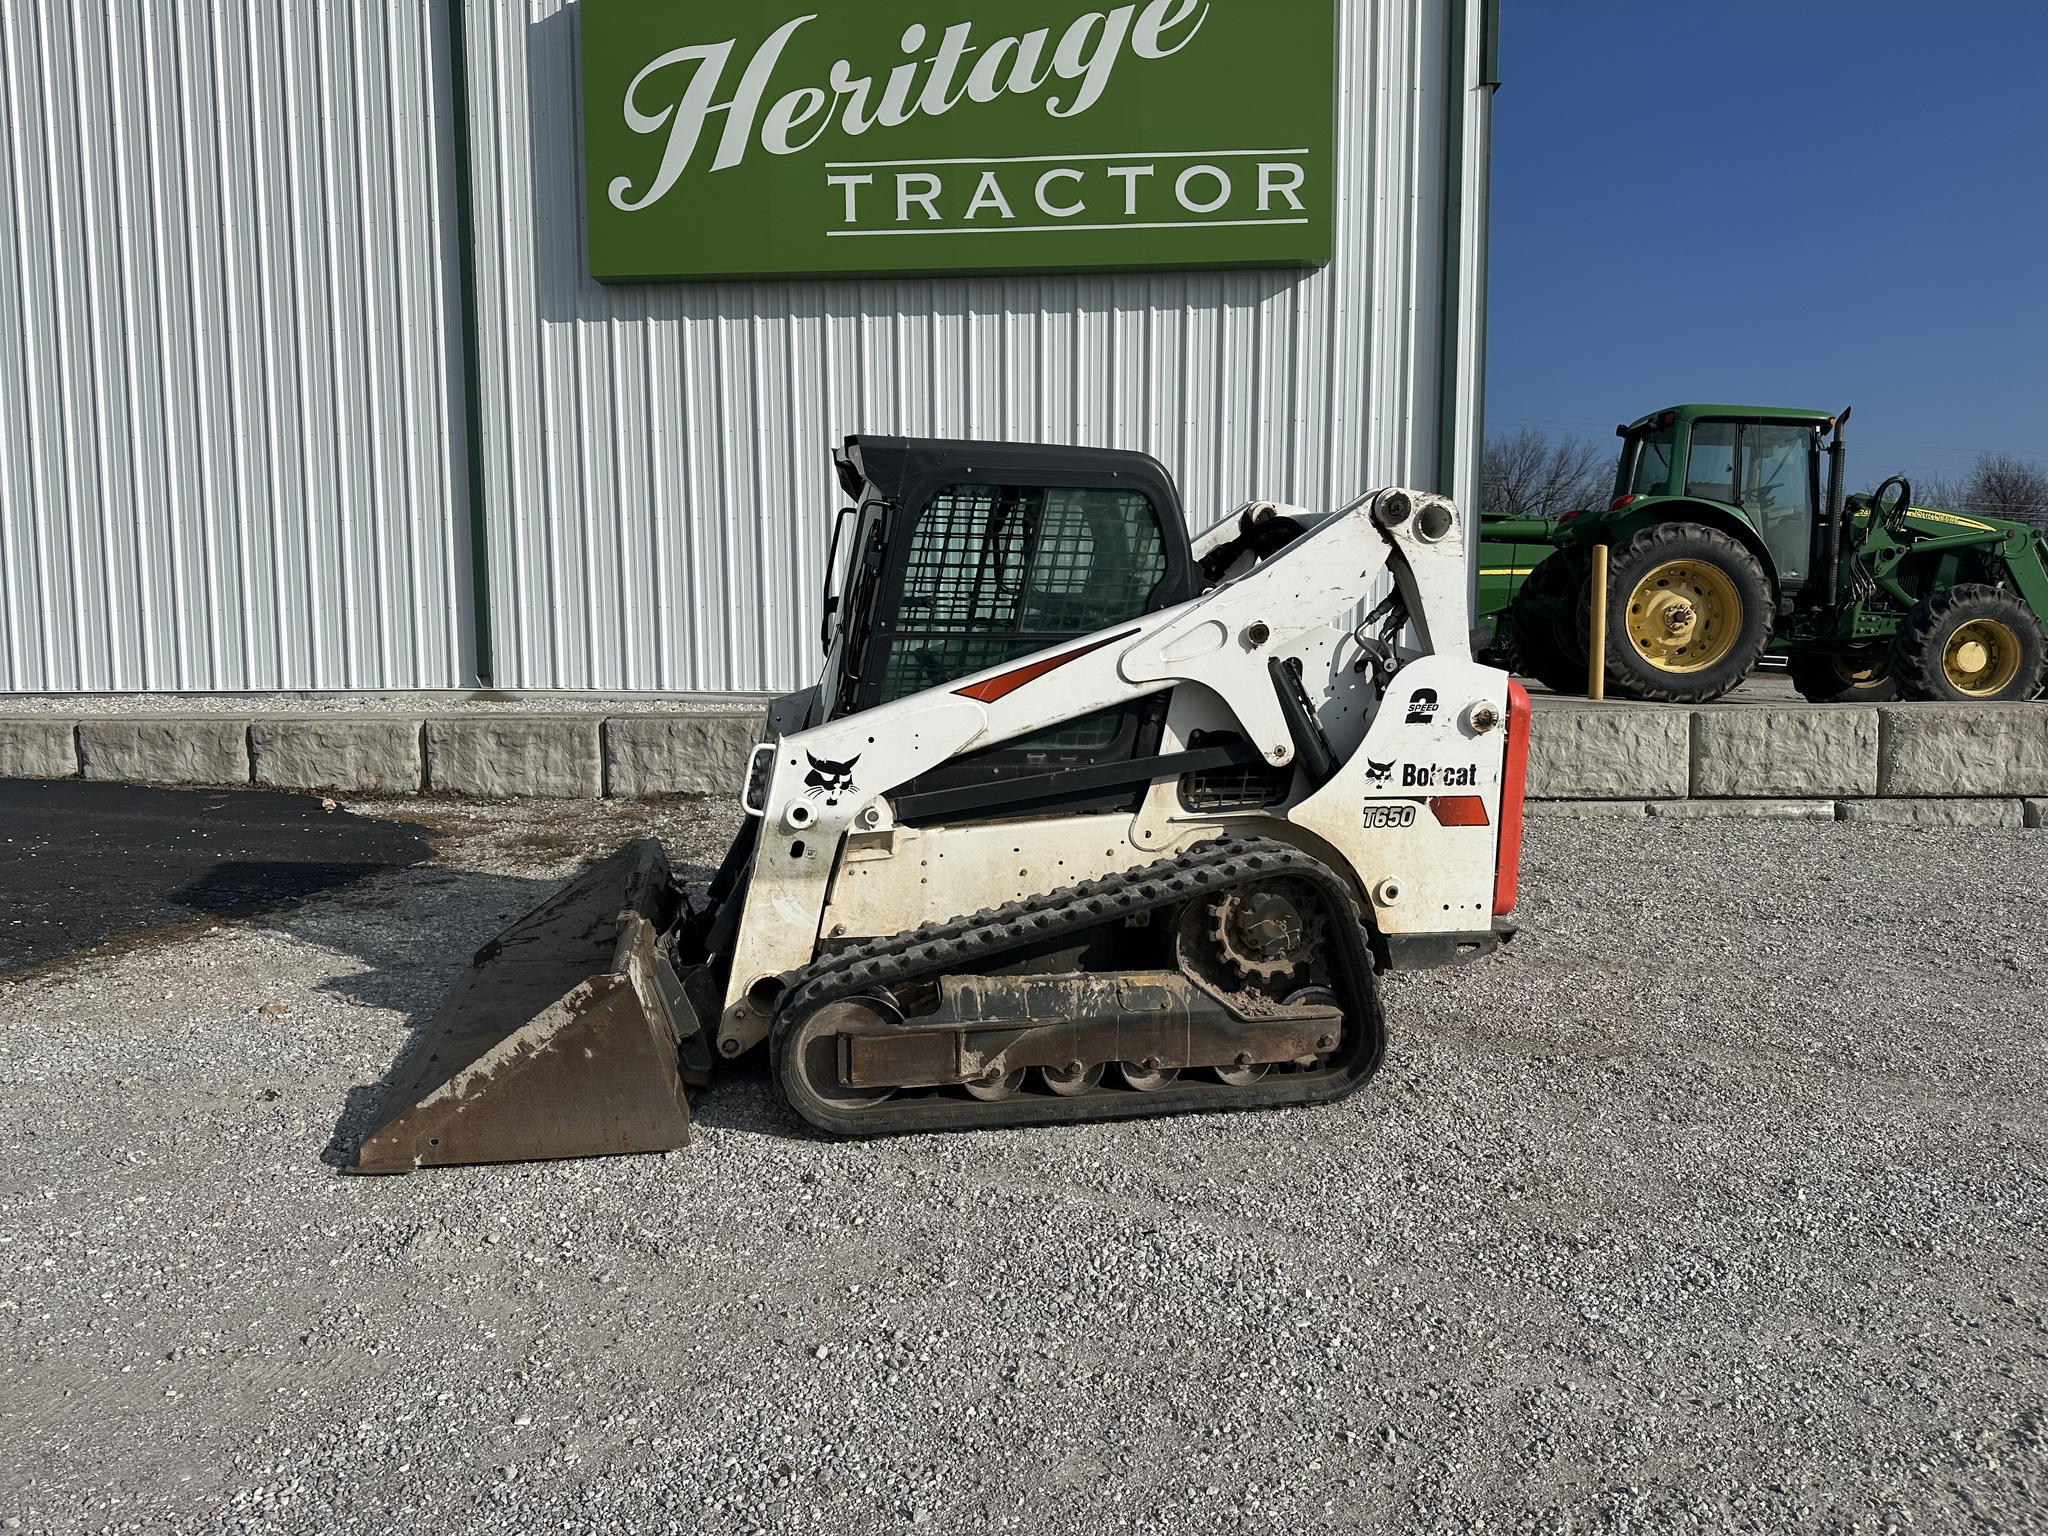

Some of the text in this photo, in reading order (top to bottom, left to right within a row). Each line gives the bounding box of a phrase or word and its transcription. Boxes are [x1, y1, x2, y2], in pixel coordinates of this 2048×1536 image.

[609, 0, 1210, 211] Heritage
[827, 163, 1306, 222] TRACTOR
[1405, 688, 1438, 724] 2
[1408, 703, 1439, 712] SPEED
[1363, 806, 1416, 828] T650
